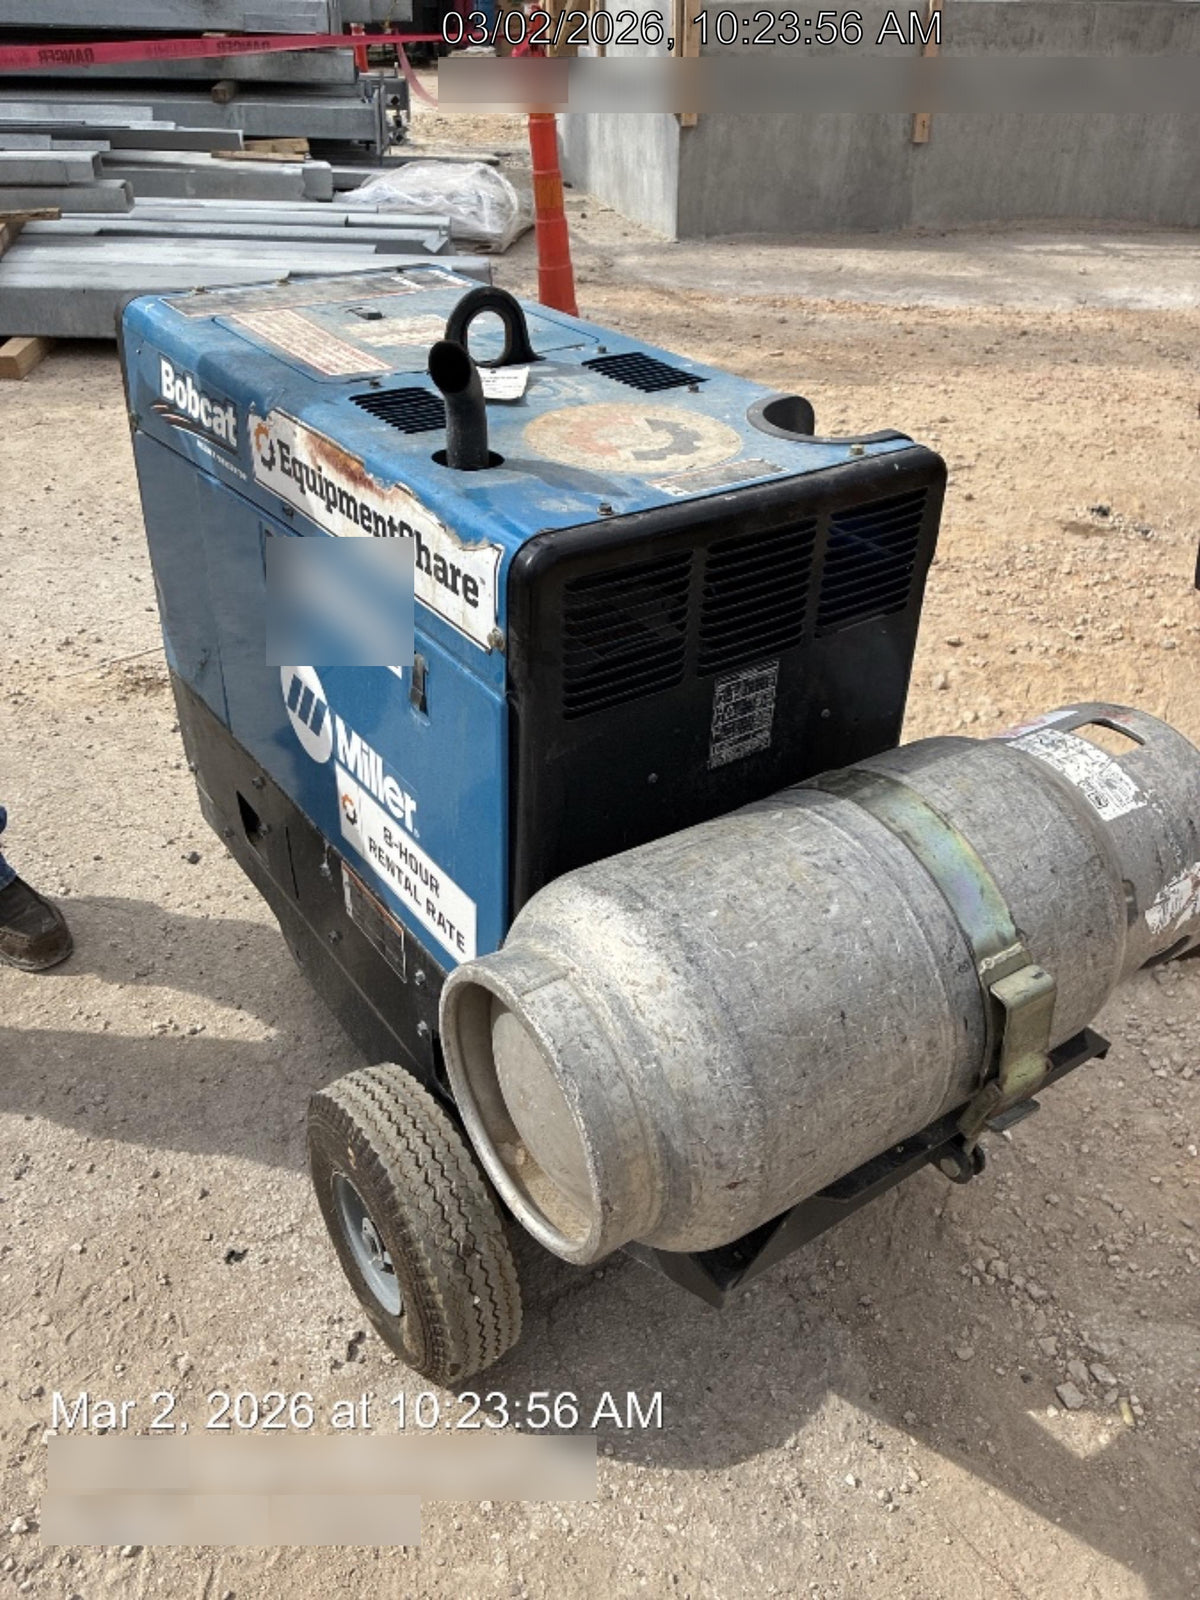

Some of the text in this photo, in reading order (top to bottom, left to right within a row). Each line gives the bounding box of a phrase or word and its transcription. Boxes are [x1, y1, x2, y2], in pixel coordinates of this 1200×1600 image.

[160, 358, 237, 447] Bobcat
[335, 714, 417, 833] Miller
[368, 836, 421, 906] RENTAL
[426, 898, 466, 954] RATE
[383, 826, 440, 898] 8-HOUR
